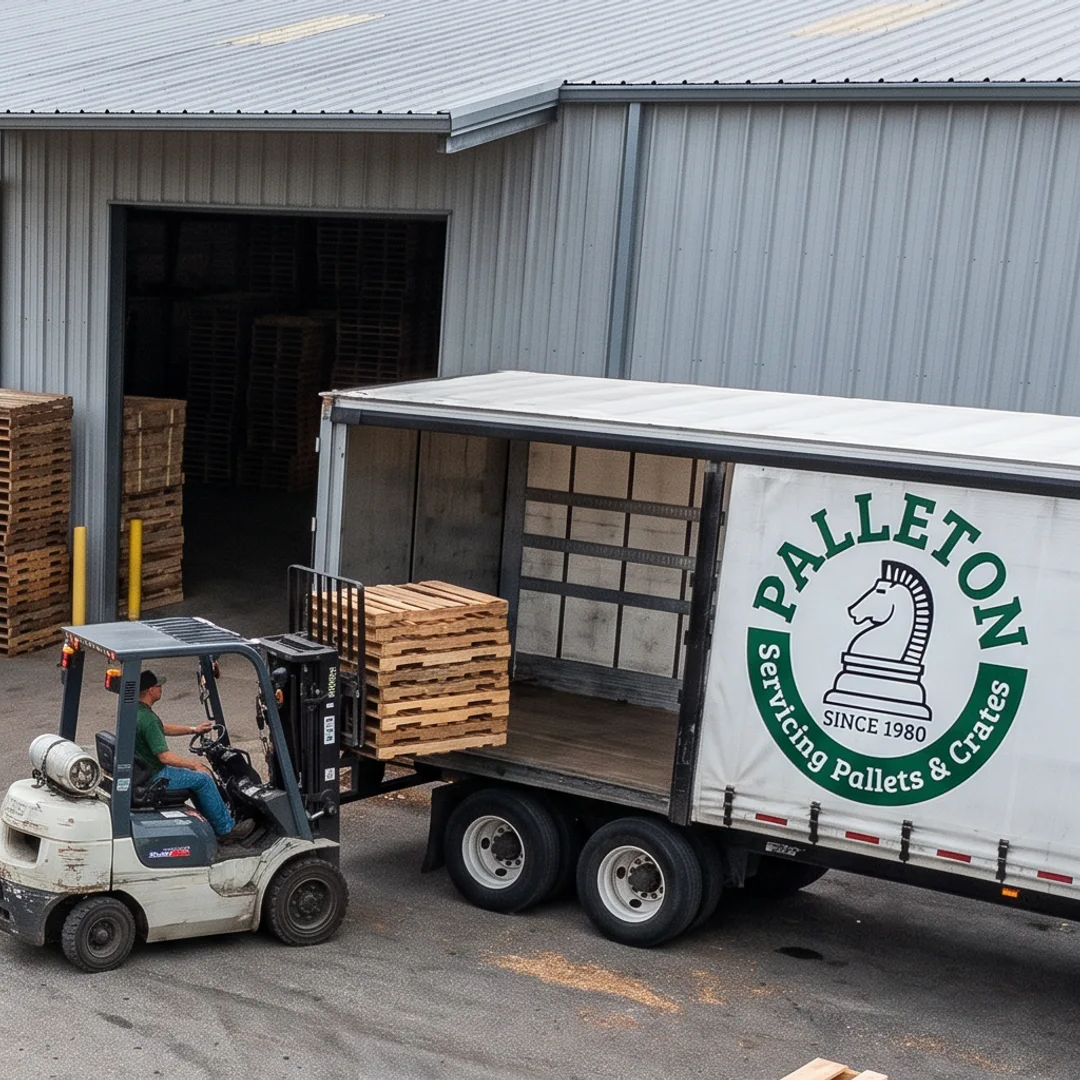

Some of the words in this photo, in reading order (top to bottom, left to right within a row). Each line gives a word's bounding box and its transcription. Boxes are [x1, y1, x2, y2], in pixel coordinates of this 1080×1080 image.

[752, 492, 1029, 650] PALLETON
[758, 643, 829, 773] Servicing
[830, 758, 924, 793] Pallets
[928, 757, 951, 781] &
[949, 680, 1010, 765] Crates
[823, 710, 879, 734] SINCE
[883, 721, 927, 742] 1980
